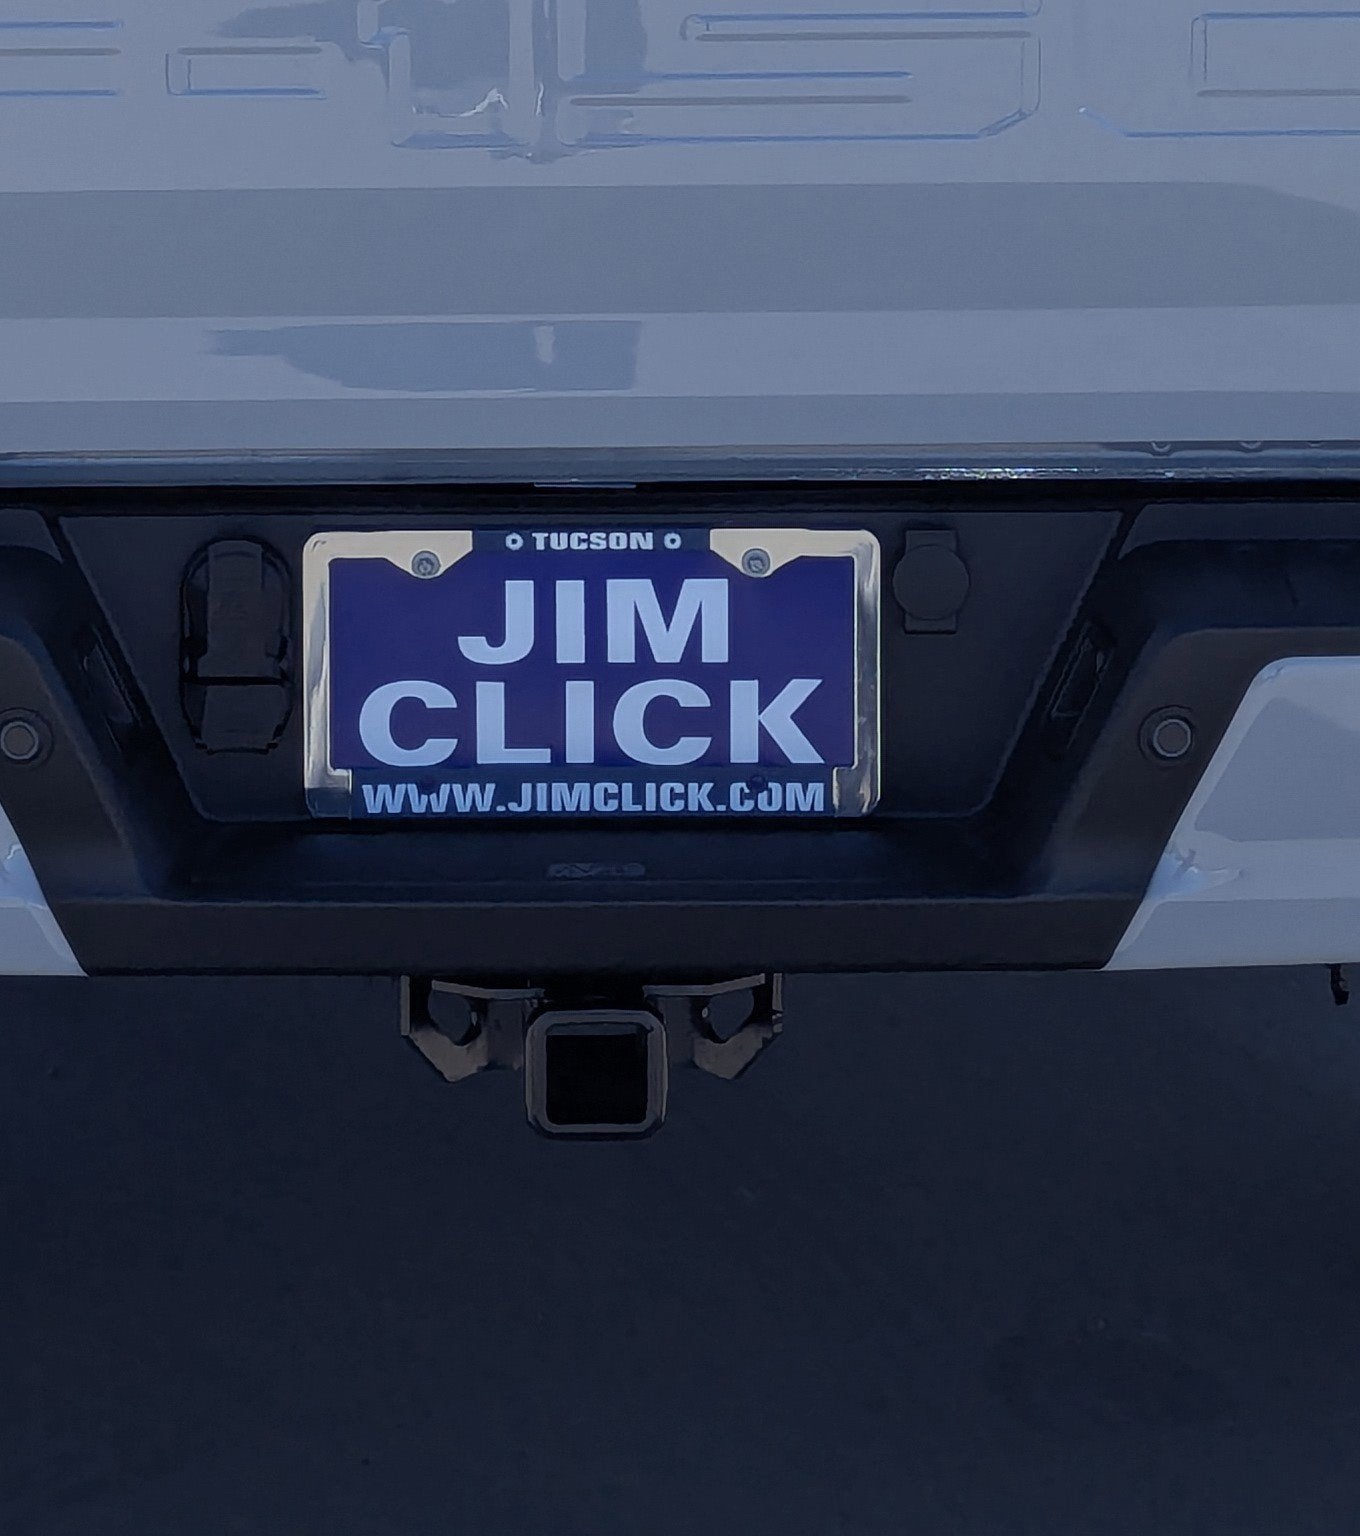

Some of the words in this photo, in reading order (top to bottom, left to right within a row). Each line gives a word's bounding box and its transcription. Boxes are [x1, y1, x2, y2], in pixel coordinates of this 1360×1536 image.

[531, 531, 654, 551] TUCSON
[456, 577, 729, 665] JIM
[357, 677, 826, 768] CLICK
[360, 781, 825, 814] WWW.JIMCLICK.COM
